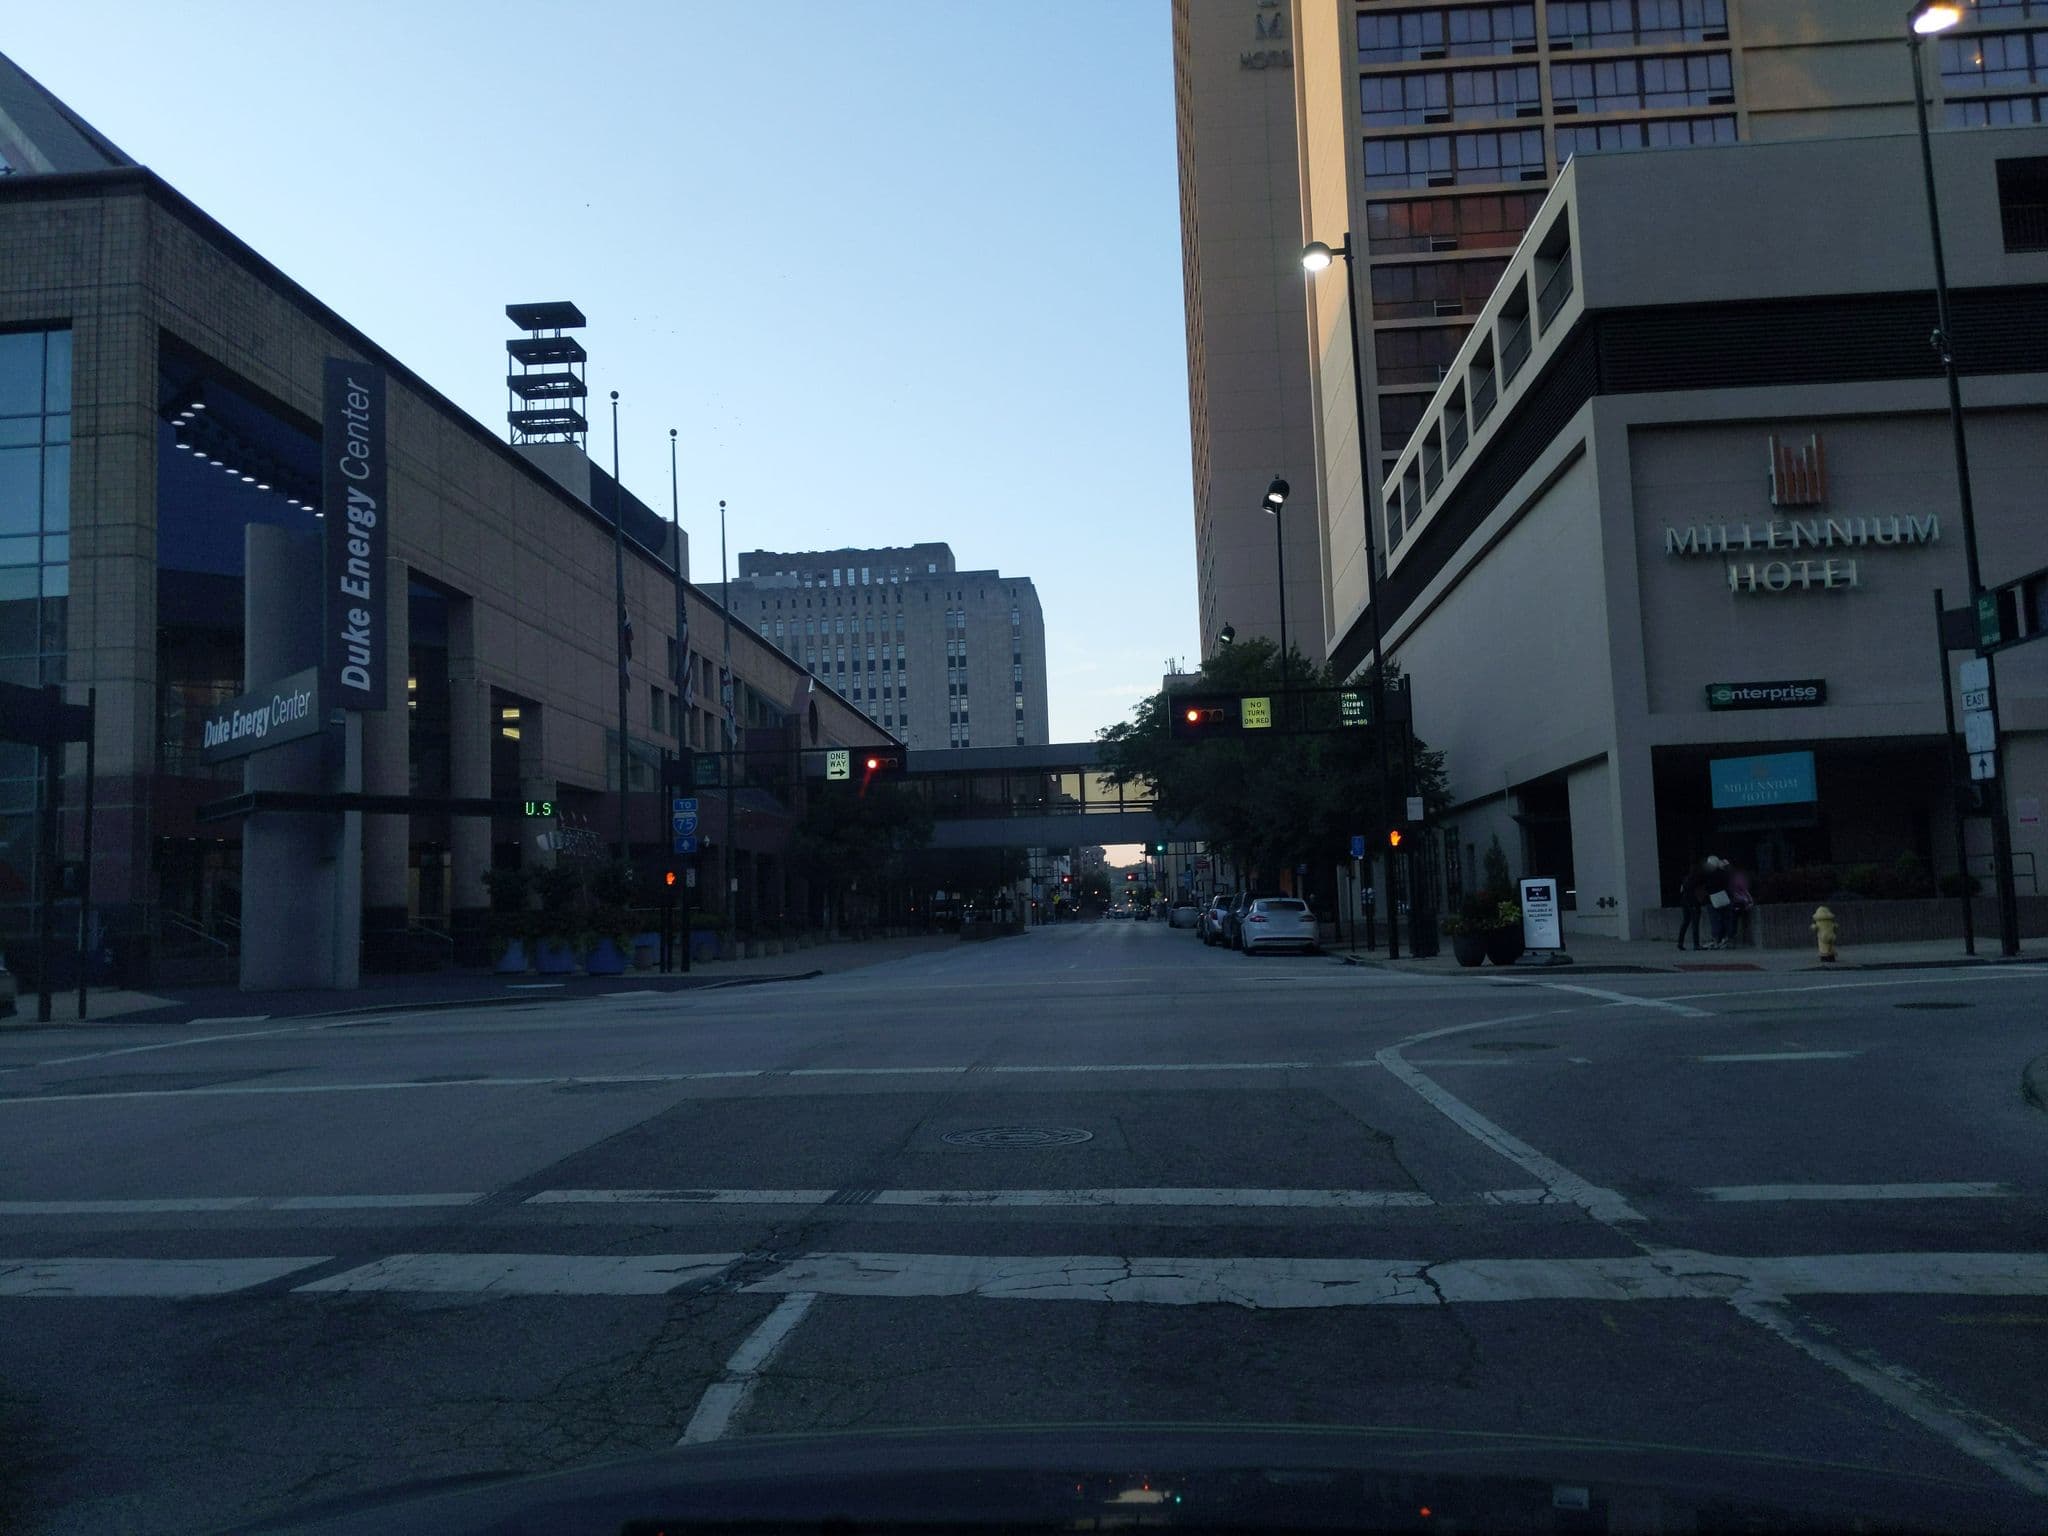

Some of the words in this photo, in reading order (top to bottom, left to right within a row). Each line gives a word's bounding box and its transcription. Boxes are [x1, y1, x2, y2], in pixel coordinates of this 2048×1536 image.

[340, 378, 369, 480] Center
[1666, 513, 1940, 553] MILLENNIUM
[341, 486, 376, 599] Energy
[1729, 559, 1861, 592] HOTEL
[341, 608, 370, 691] Duke
[1341, 692, 1357, 700] Fifth
[1717, 684, 1818, 702] enterprise
[1341, 700, 1364, 708] Street
[1966, 694, 1985, 707] EAST
[204, 716, 231, 749] Duke
[231, 706, 270, 738] Energy
[271, 690, 311, 726] Center
[1247, 709, 1265, 717] TURN
[830, 752, 846, 760] ONE
[830, 760, 846, 768] WAY
[1721, 776, 1800, 792] MILLENNIUM
[679, 801, 692, 809] TO
[676, 818, 694, 830] 75
